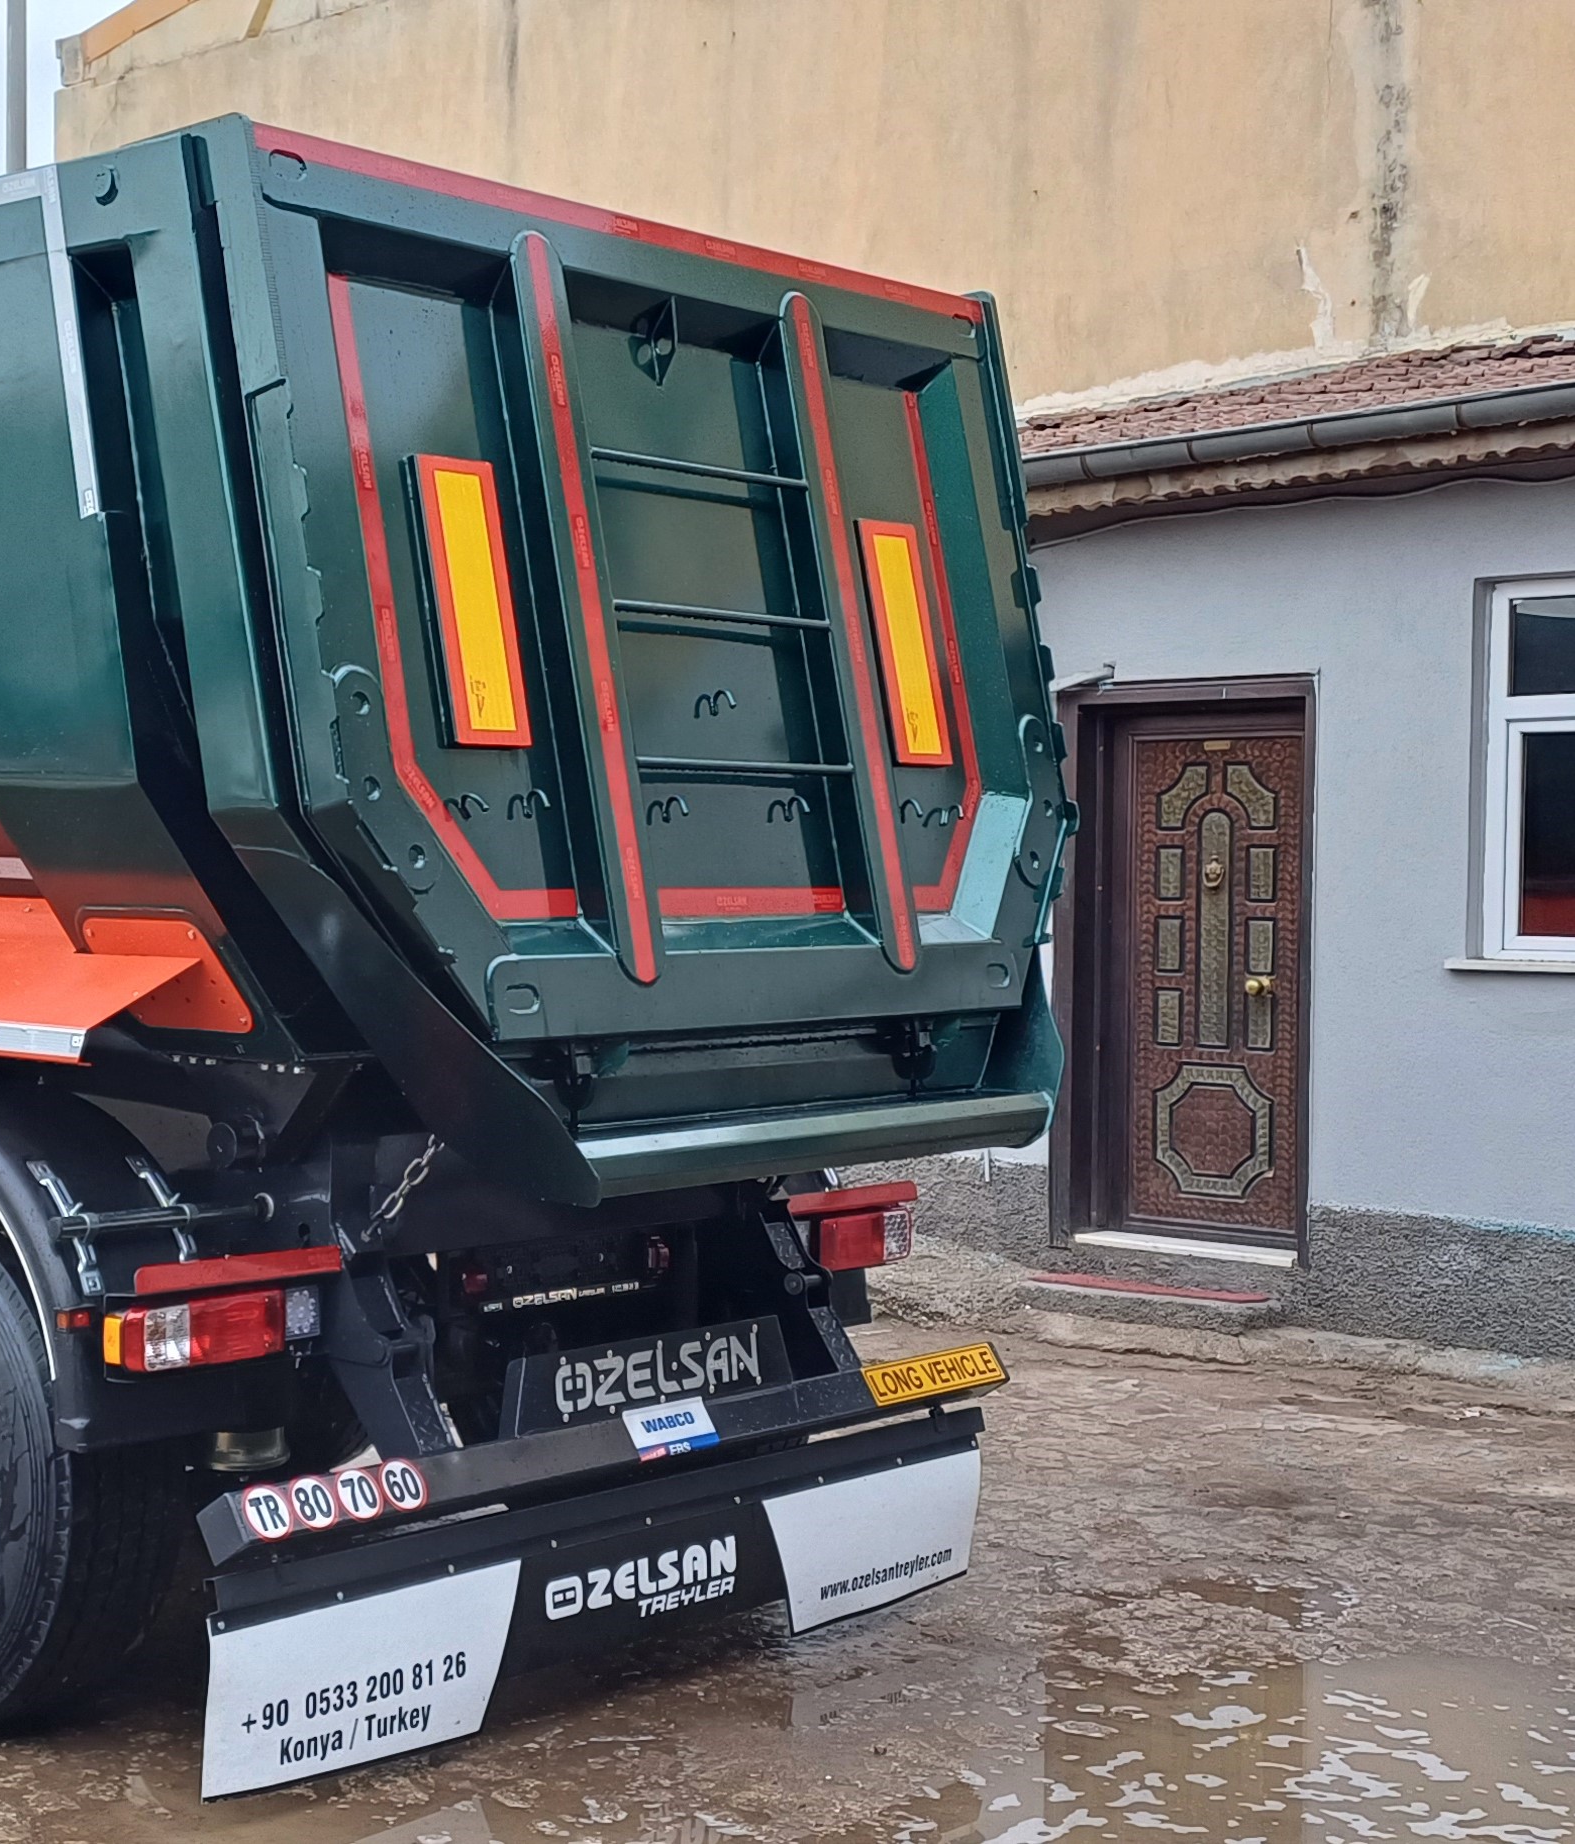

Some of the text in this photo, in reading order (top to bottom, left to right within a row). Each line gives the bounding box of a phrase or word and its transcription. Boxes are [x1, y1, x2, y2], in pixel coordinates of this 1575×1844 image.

[869, 1351, 997, 1397] LONG VEHICLE
[641, 1411, 695, 1433] WABCO
[248, 1467, 421, 1531] TR 80 70 60
[638, 1575, 735, 1617] TREYLER
[820, 1548, 952, 1600] www.ozelsantreyler.com
[241, 1651, 466, 1733] +90 0533 200 81 26
[280, 1704, 431, 1765] Konya / Turkey
